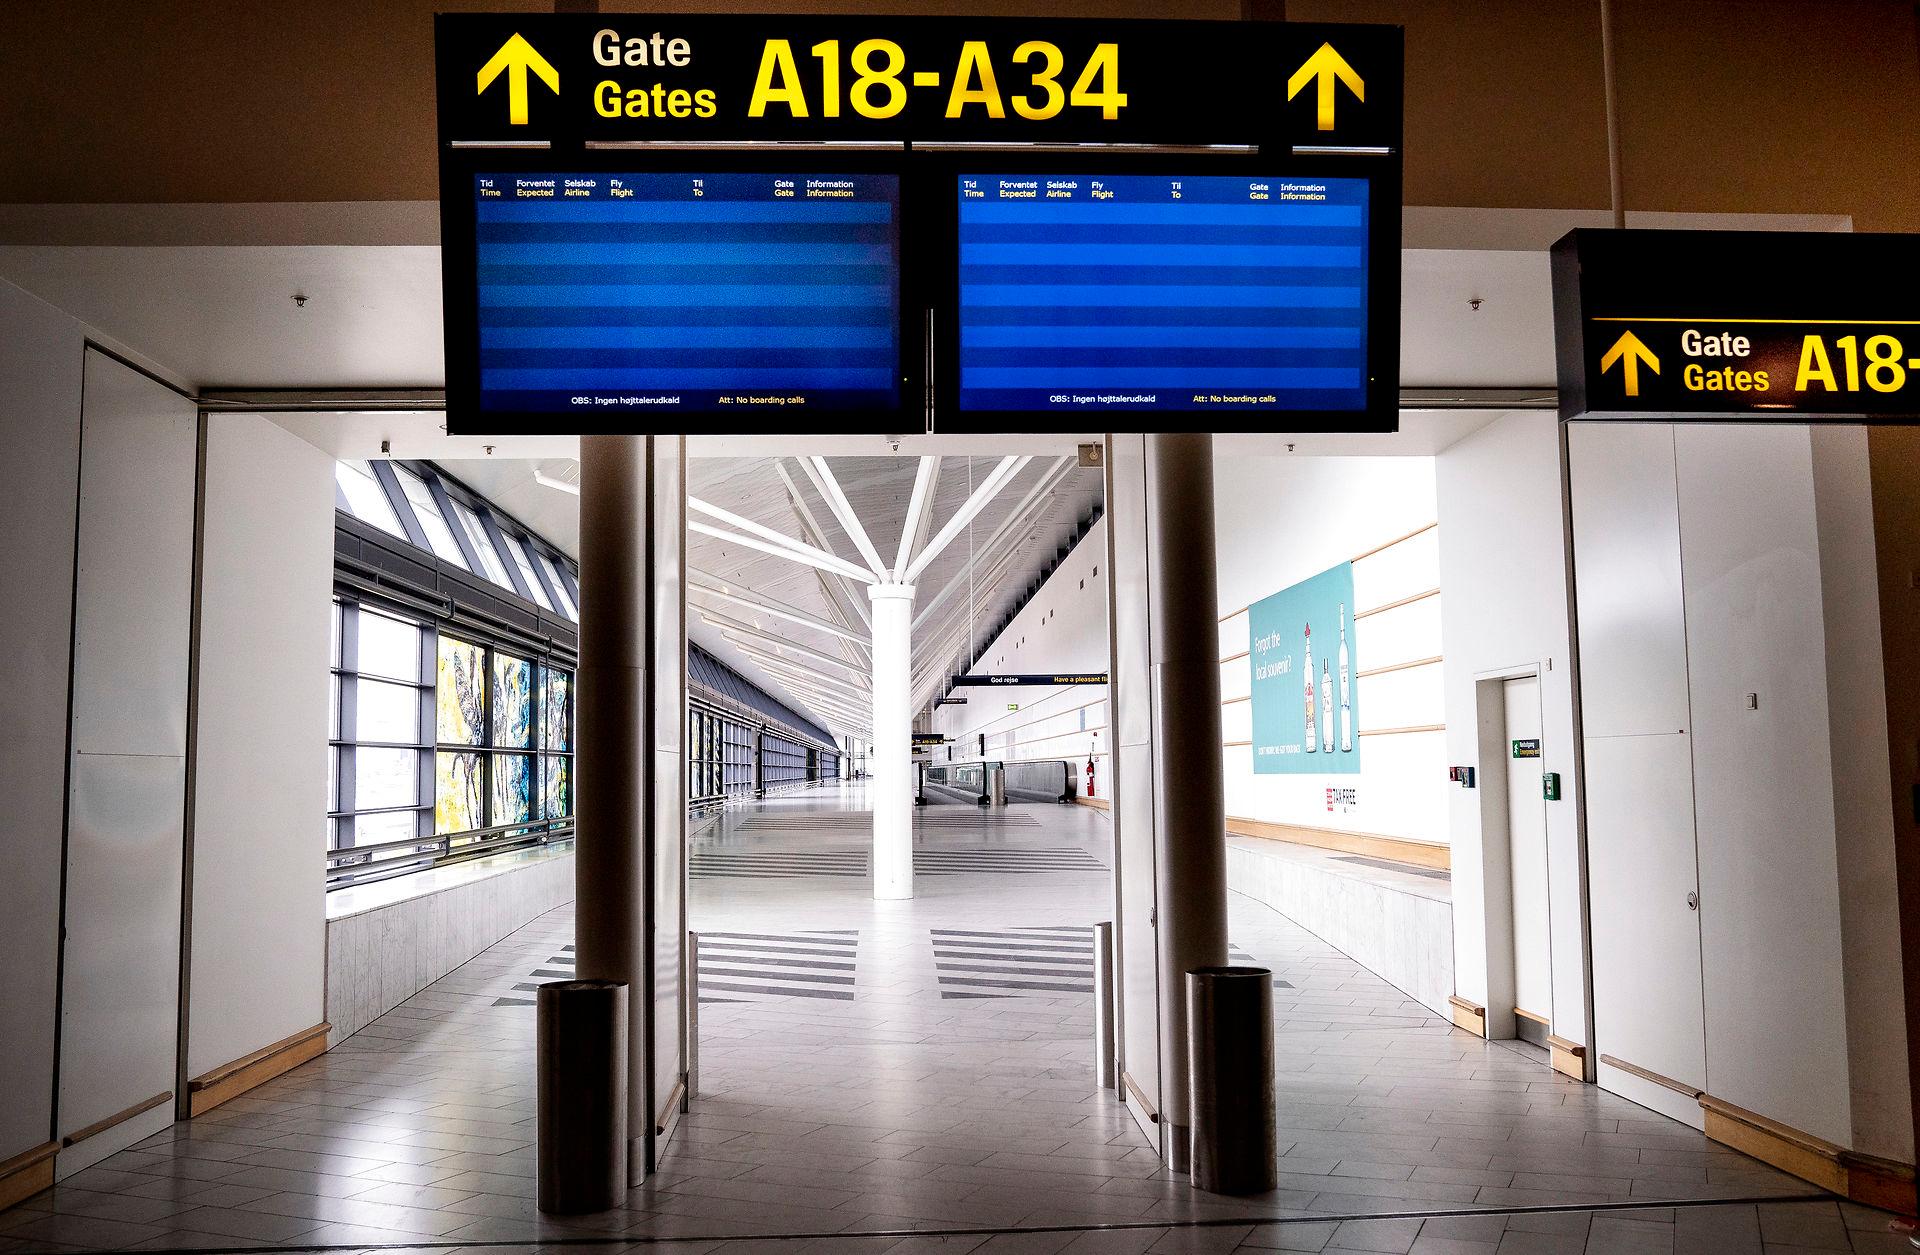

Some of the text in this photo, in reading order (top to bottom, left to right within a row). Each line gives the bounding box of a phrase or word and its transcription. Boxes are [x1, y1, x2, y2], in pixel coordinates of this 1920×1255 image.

[592, 28, 692, 67] Gate
[747, 38, 1128, 121] A18-A34
[593, 79, 718, 119] Gates
[479, 179, 854, 189] Tid Forventet Selskab Fly Til Gate Information
[963, 180, 1326, 192] Tid Forventet Selskab Fly Til Gate Information
[480, 188, 854, 199] Time Expected Airline Flight To Gate Information
[963, 189, 1326, 201] Time Expected Airline Flight To Gate Information
[1681, 329, 1751, 357] Gate
[1683, 363, 1770, 392] Gates
[571, 396, 680, 406] OBS: Ingen højttalerudkald
[718, 396, 805, 406] Att: No boarding calls
[1049, 394, 1156, 405] OBS: Ingen højttalerudkald
[1192, 394, 1277, 405] Att: No boarding calls
[1271, 630, 1281, 648] the
[1255, 660, 1268, 680] local
[990, 676, 1003, 684] God
[1075, 676, 1101, 684] pleasant
